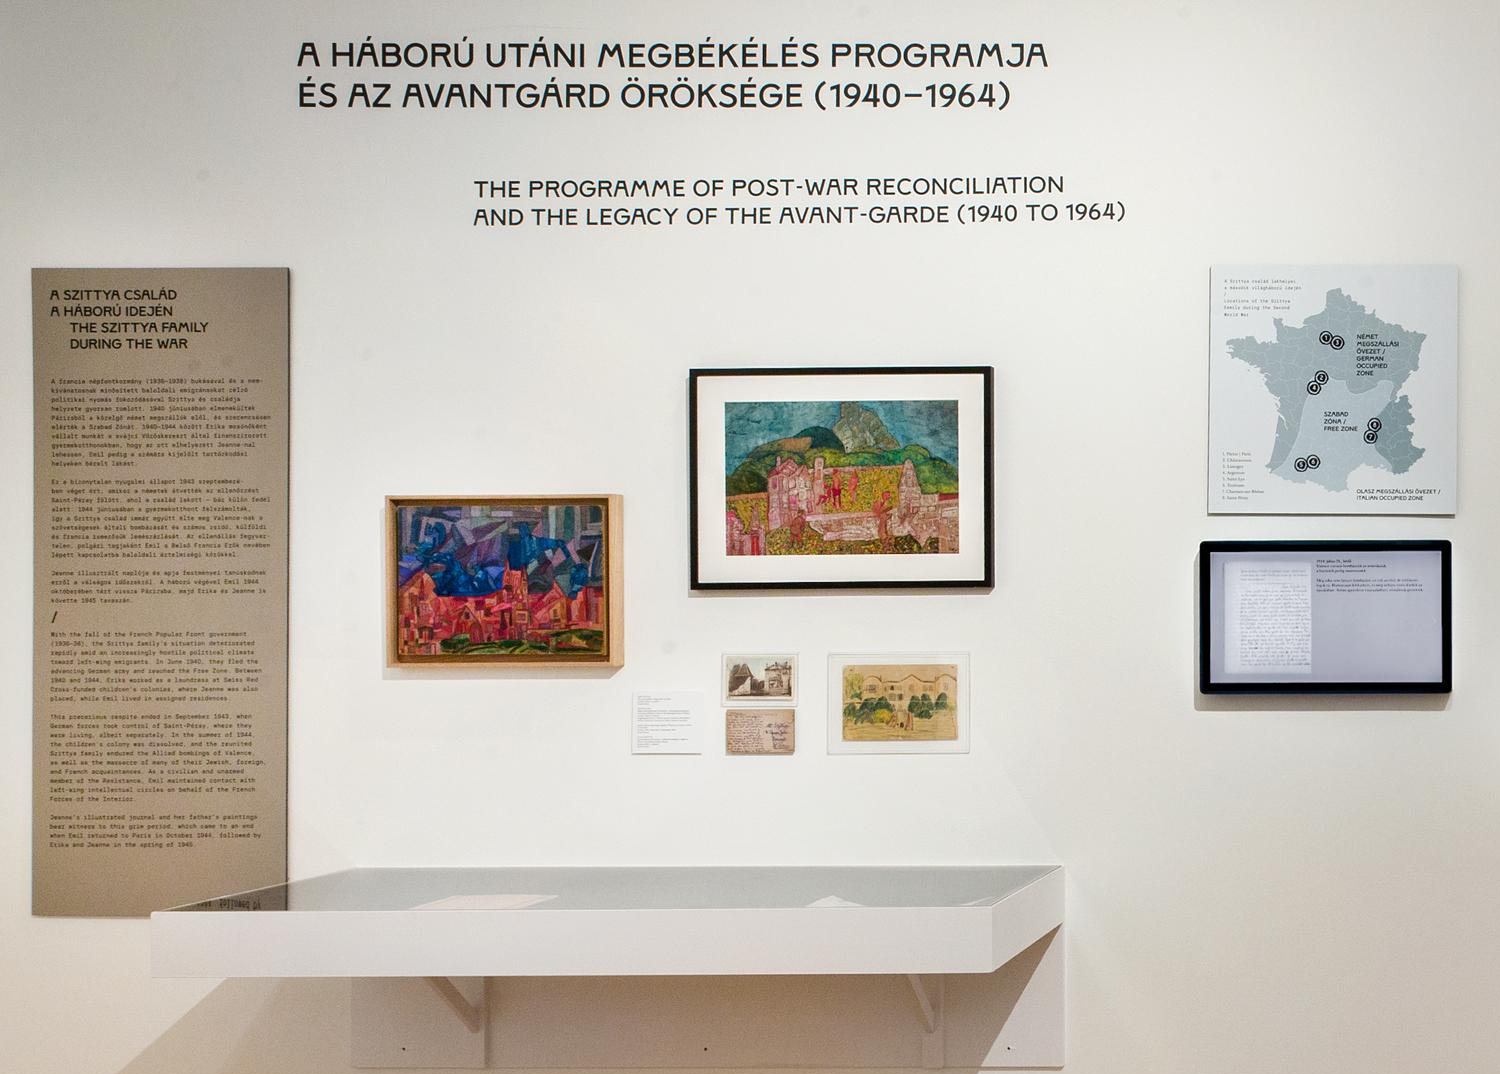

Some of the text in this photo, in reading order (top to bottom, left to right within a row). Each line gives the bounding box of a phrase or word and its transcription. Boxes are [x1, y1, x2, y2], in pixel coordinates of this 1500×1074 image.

[297, 36, 1048, 68] A HÁBORÚ UTÁNI MEGBÉKÉLÉS PROGRAMJA
[299, 76, 338, 108] ÉS
[348, 83, 392, 108] AZ
[402, 77, 610, 108] AVANTGÁRD
[620, 77, 803, 108] ÖRÖKSÉGE
[474, 175, 1064, 198] THE PROGRAMME OF POST-WAR RECONCILIATION
[473, 201, 1126, 226] AND THE LEGACY OF THE AVANT-GARDE (1940 TO 1964)
[50, 287, 177, 301] A SZITTYA CSALÁD
[50, 304, 173, 317] A HÁBORÚ IDEJÉN
[70, 322, 209, 333] THE SZITTYA FAMILY
[70, 338, 188, 349] DURING THE WAR
